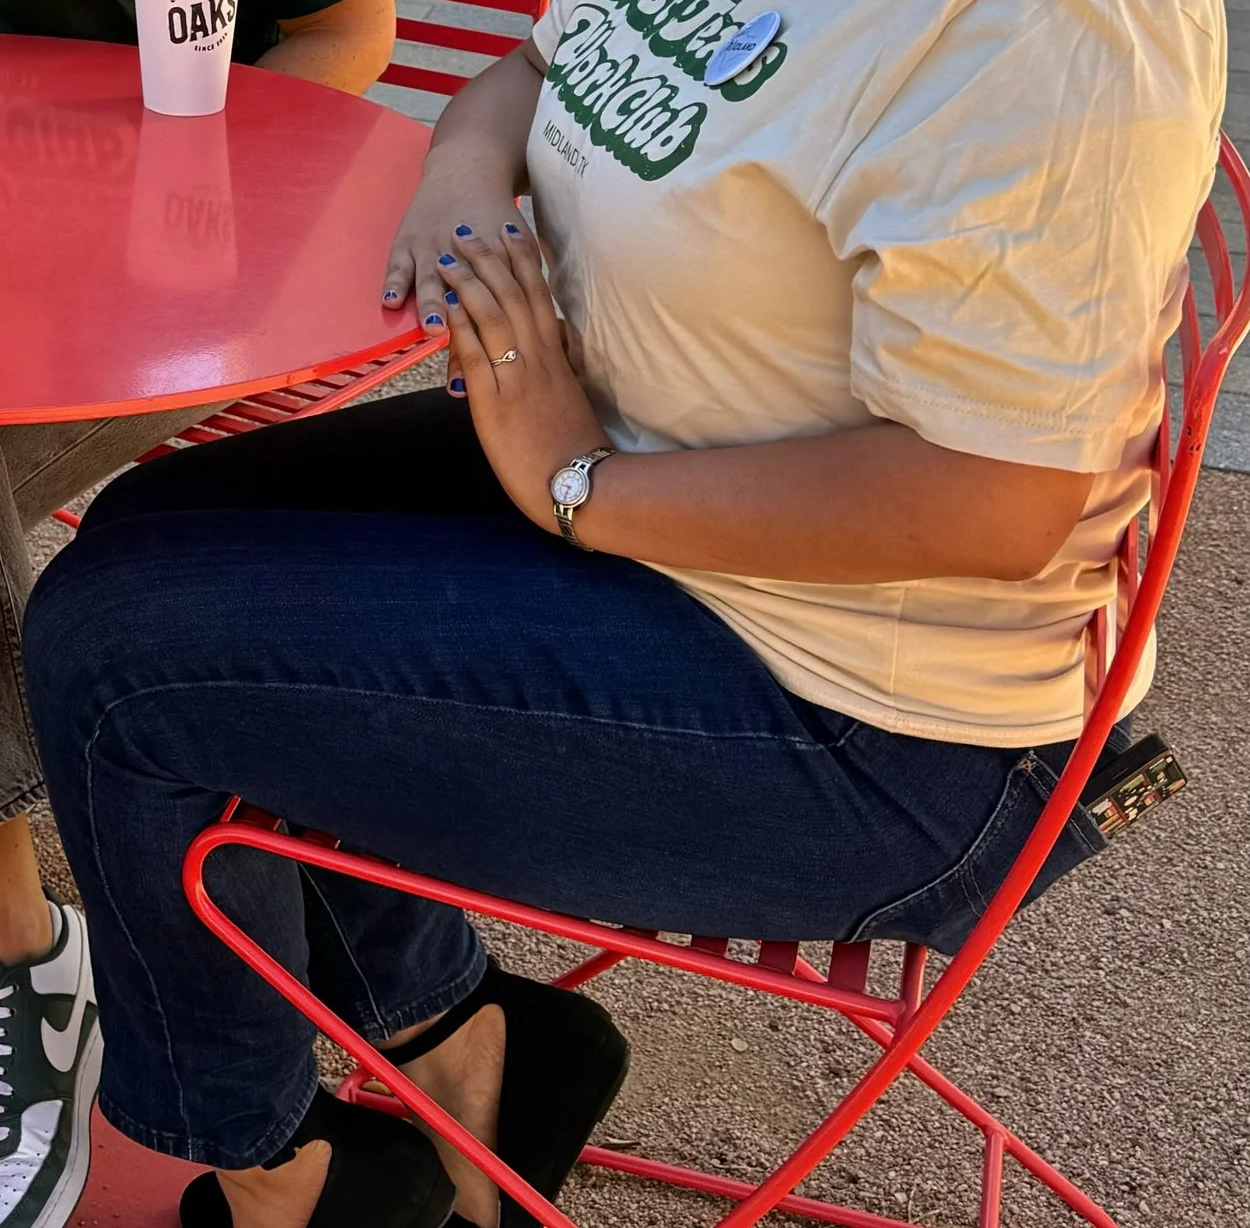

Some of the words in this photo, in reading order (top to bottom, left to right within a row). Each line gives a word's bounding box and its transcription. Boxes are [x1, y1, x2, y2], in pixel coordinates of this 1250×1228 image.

[194, 44, 214, 52] SINCE
[546, 3, 640, 129] Work
[590, 75, 708, 181] Club
